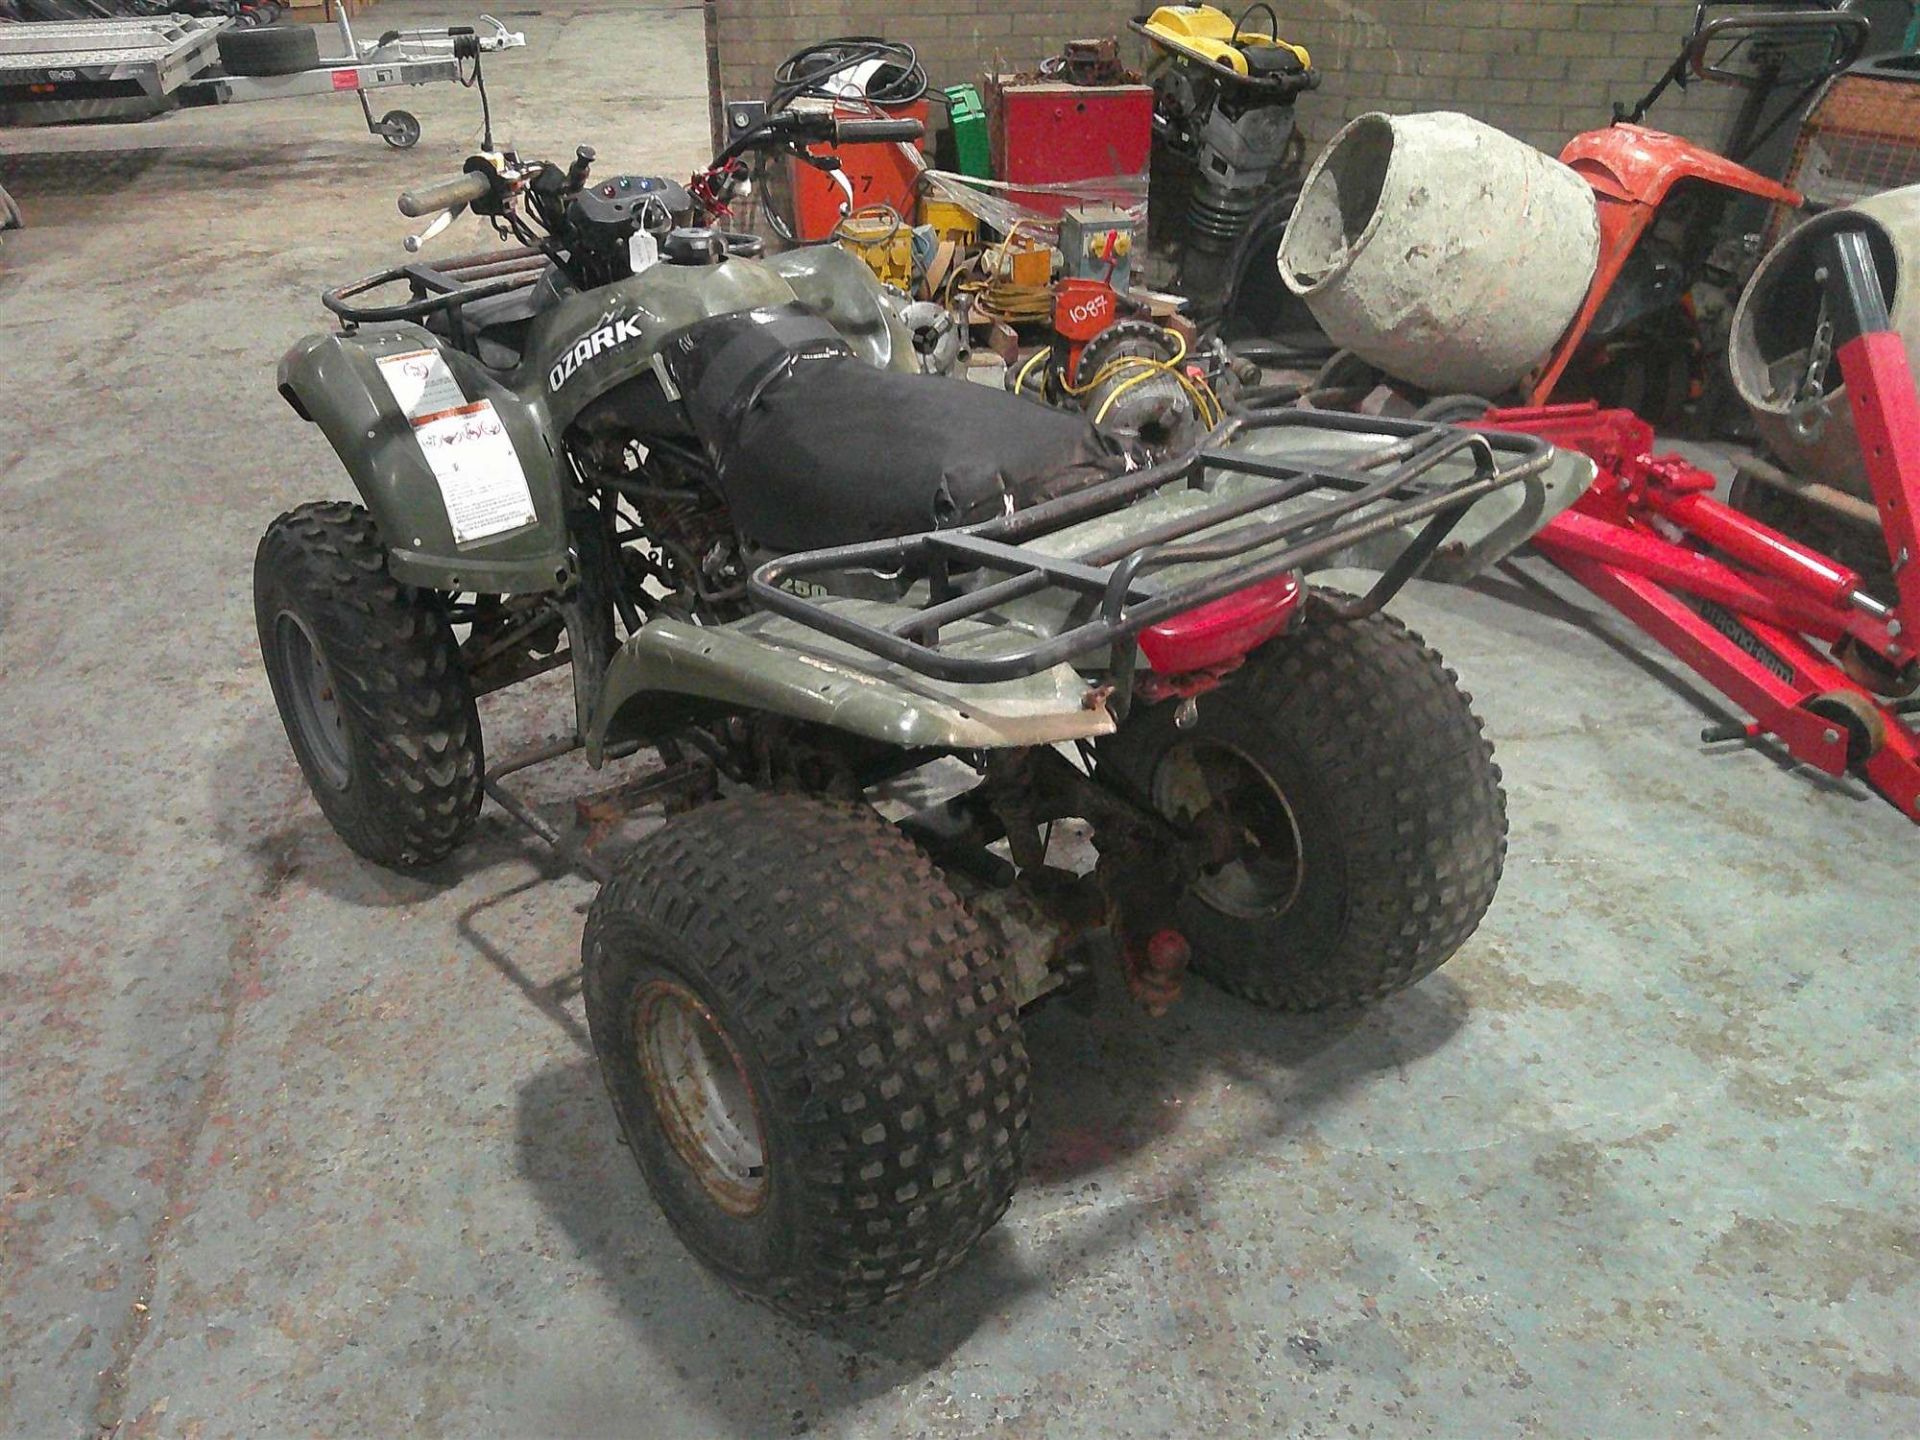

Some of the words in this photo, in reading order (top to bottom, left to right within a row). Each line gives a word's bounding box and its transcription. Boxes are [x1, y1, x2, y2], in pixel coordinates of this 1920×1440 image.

[825, 175, 873, 193] 77
[1069, 294, 1108, 324] 1087
[549, 312, 643, 392] OZARK
